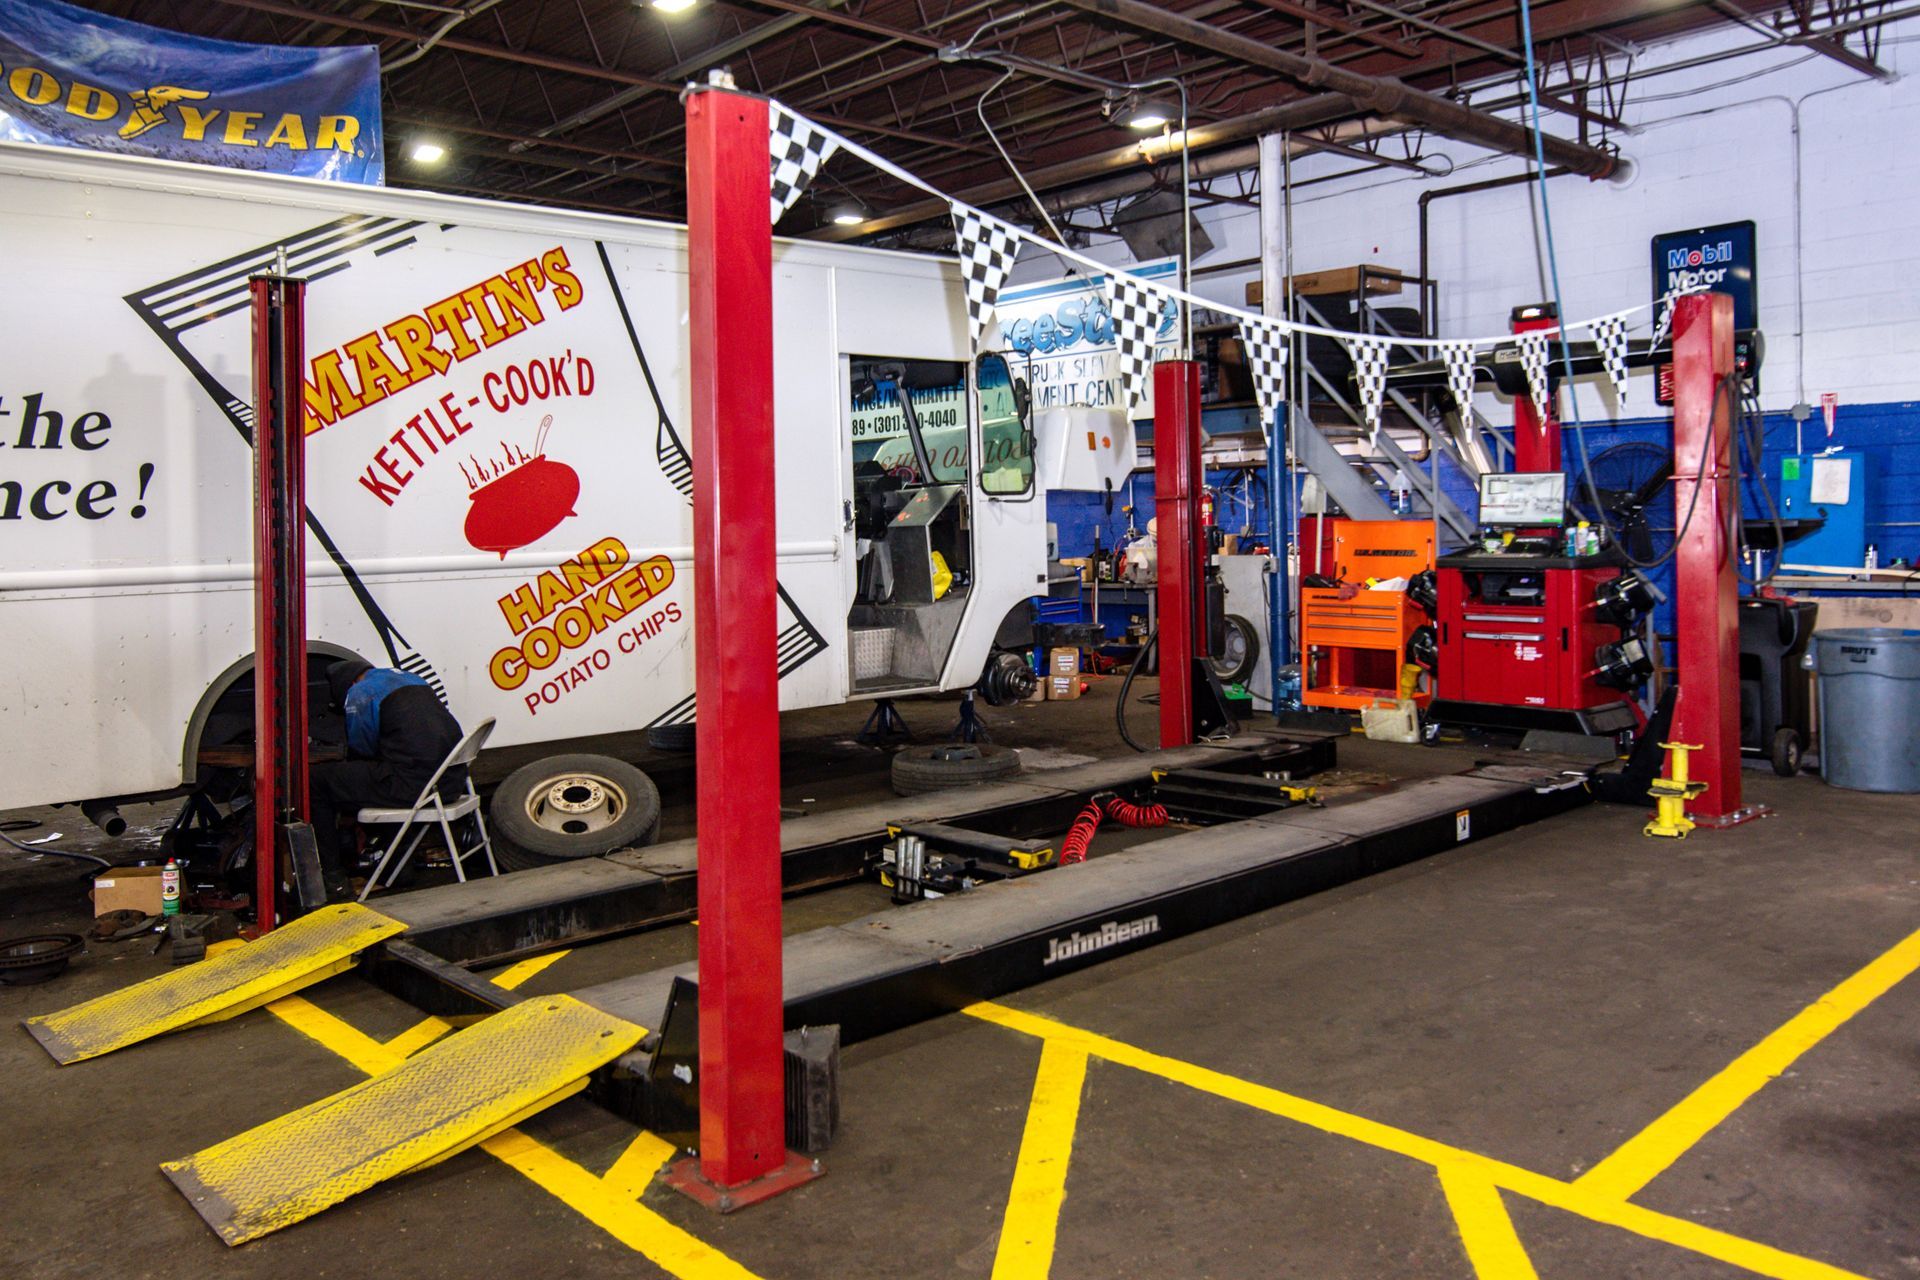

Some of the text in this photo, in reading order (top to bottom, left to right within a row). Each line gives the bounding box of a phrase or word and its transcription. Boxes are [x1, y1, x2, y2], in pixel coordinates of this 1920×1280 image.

[0, 62, 361, 155] OD YEAR
[1668, 241, 1732, 269] Mobil
[1669, 267, 1727, 289] Motor
[305, 246, 584, 437] MARTIN'S
[359, 349, 595, 507] KETTLE-COOK'D
[874, 414, 900, 434] (301)
[903, 408, 957, 431] 30-4040
[1086, 376, 1147, 406] CENTR
[489, 555, 675, 691] COOKED
[497, 537, 630, 636] HAND
[524, 602, 683, 716] POTATO CHIPS
[1043, 914, 1159, 966] JohnBean
